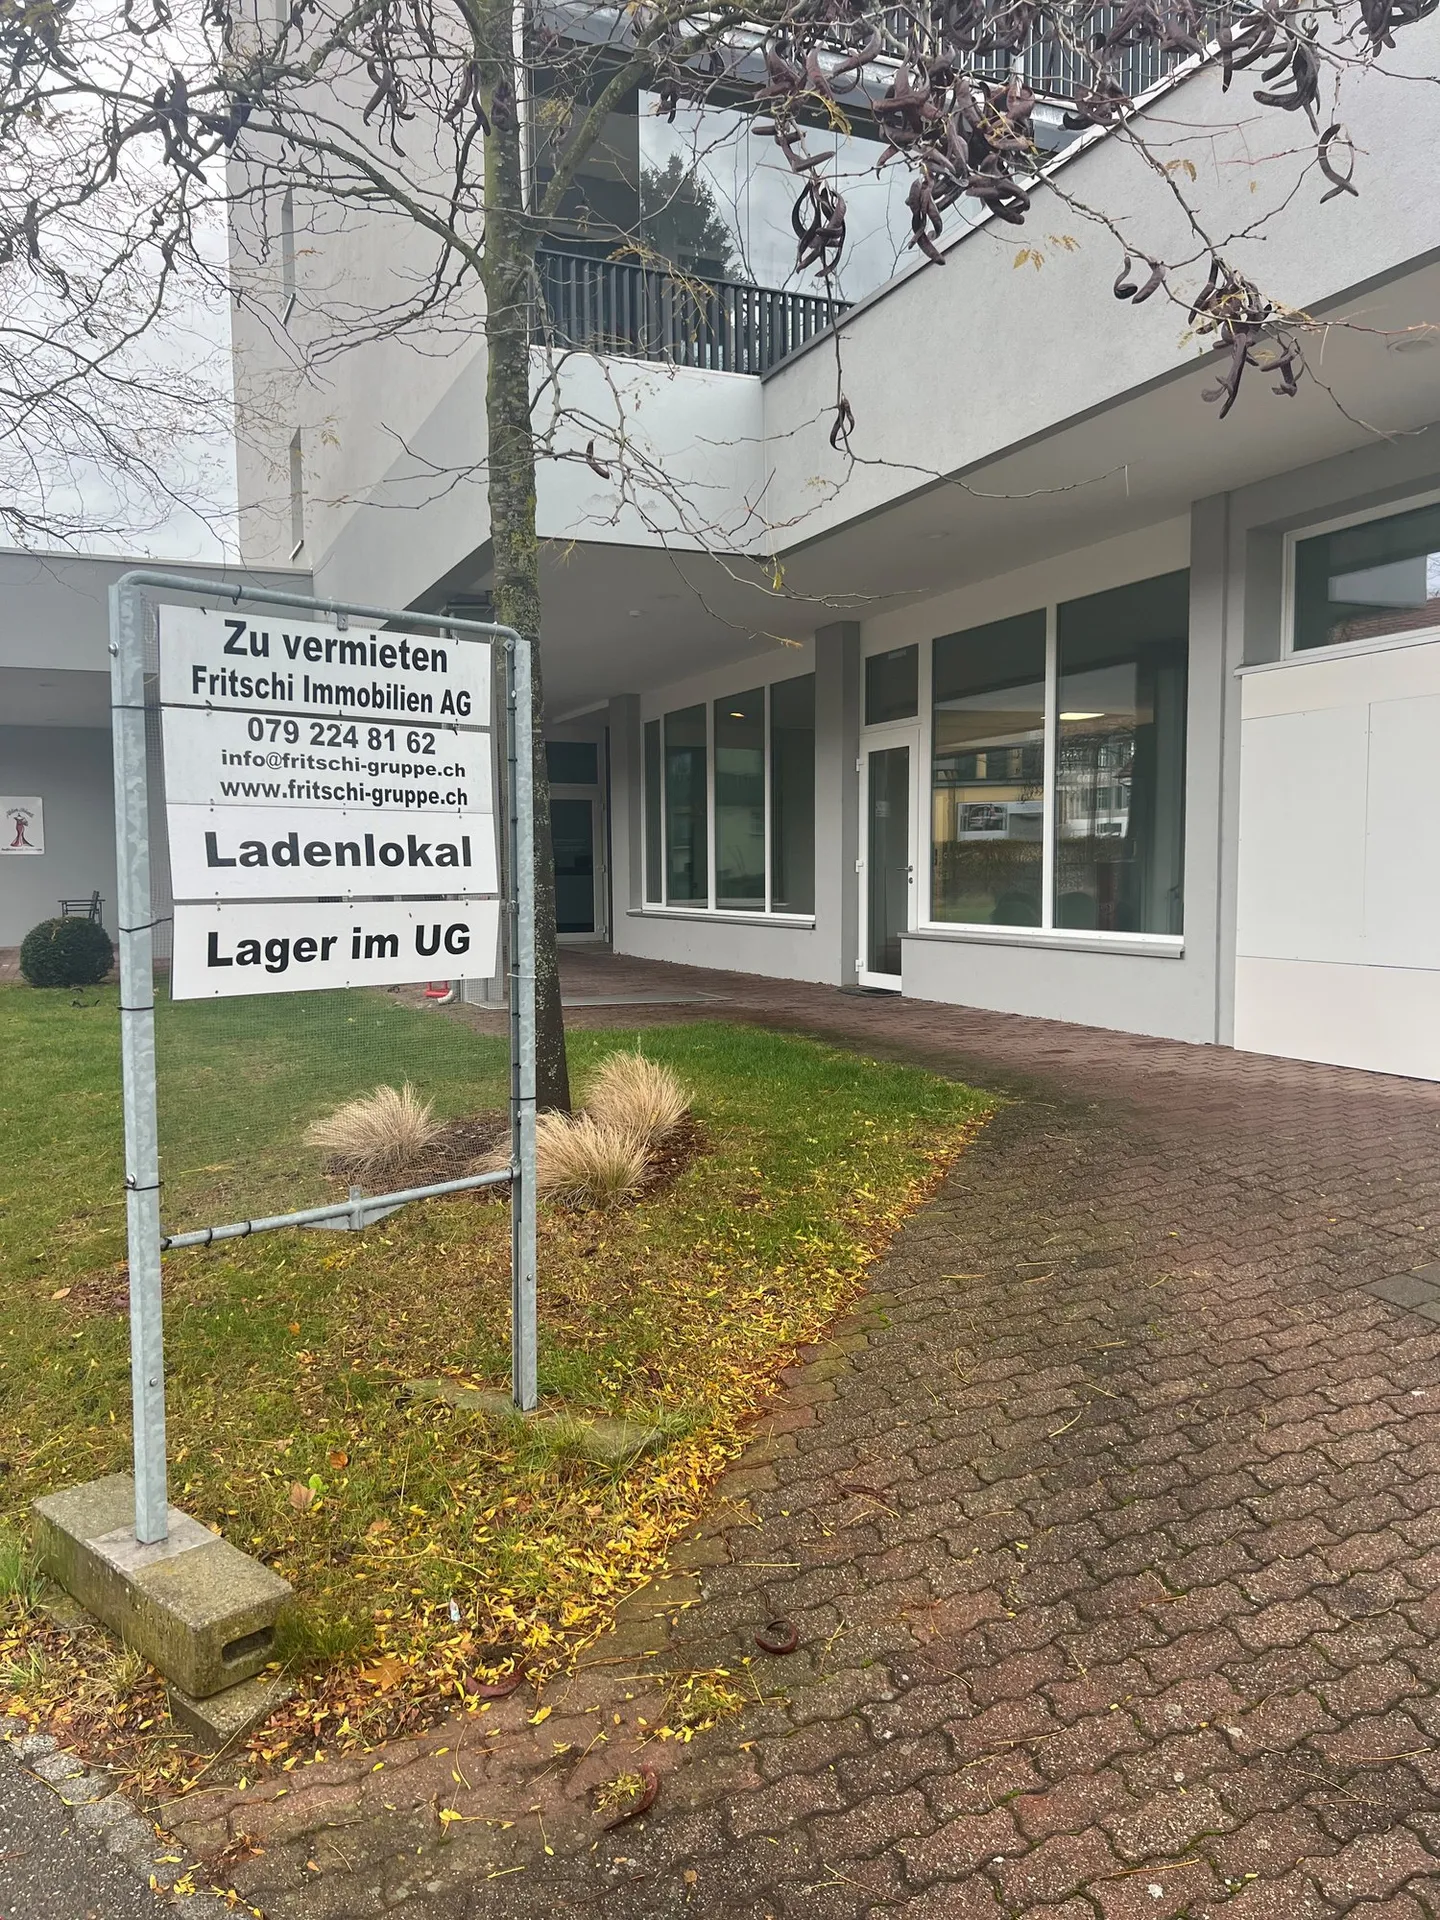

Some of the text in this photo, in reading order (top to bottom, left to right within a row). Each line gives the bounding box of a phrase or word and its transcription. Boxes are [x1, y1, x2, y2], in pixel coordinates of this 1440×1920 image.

[224, 619, 448, 672] Zu vermieten
[193, 665, 470, 716] Fritschi Immobilien AG
[248, 716, 435, 754] 079 224 81 62
[222, 748, 465, 778] info@fritschi-gruppe.ch
[220, 779, 467, 808] www.fritschi-gruppe.ch
[205, 832, 471, 867] Ladenlokal
[208, 924, 469, 973] Lager im UG
